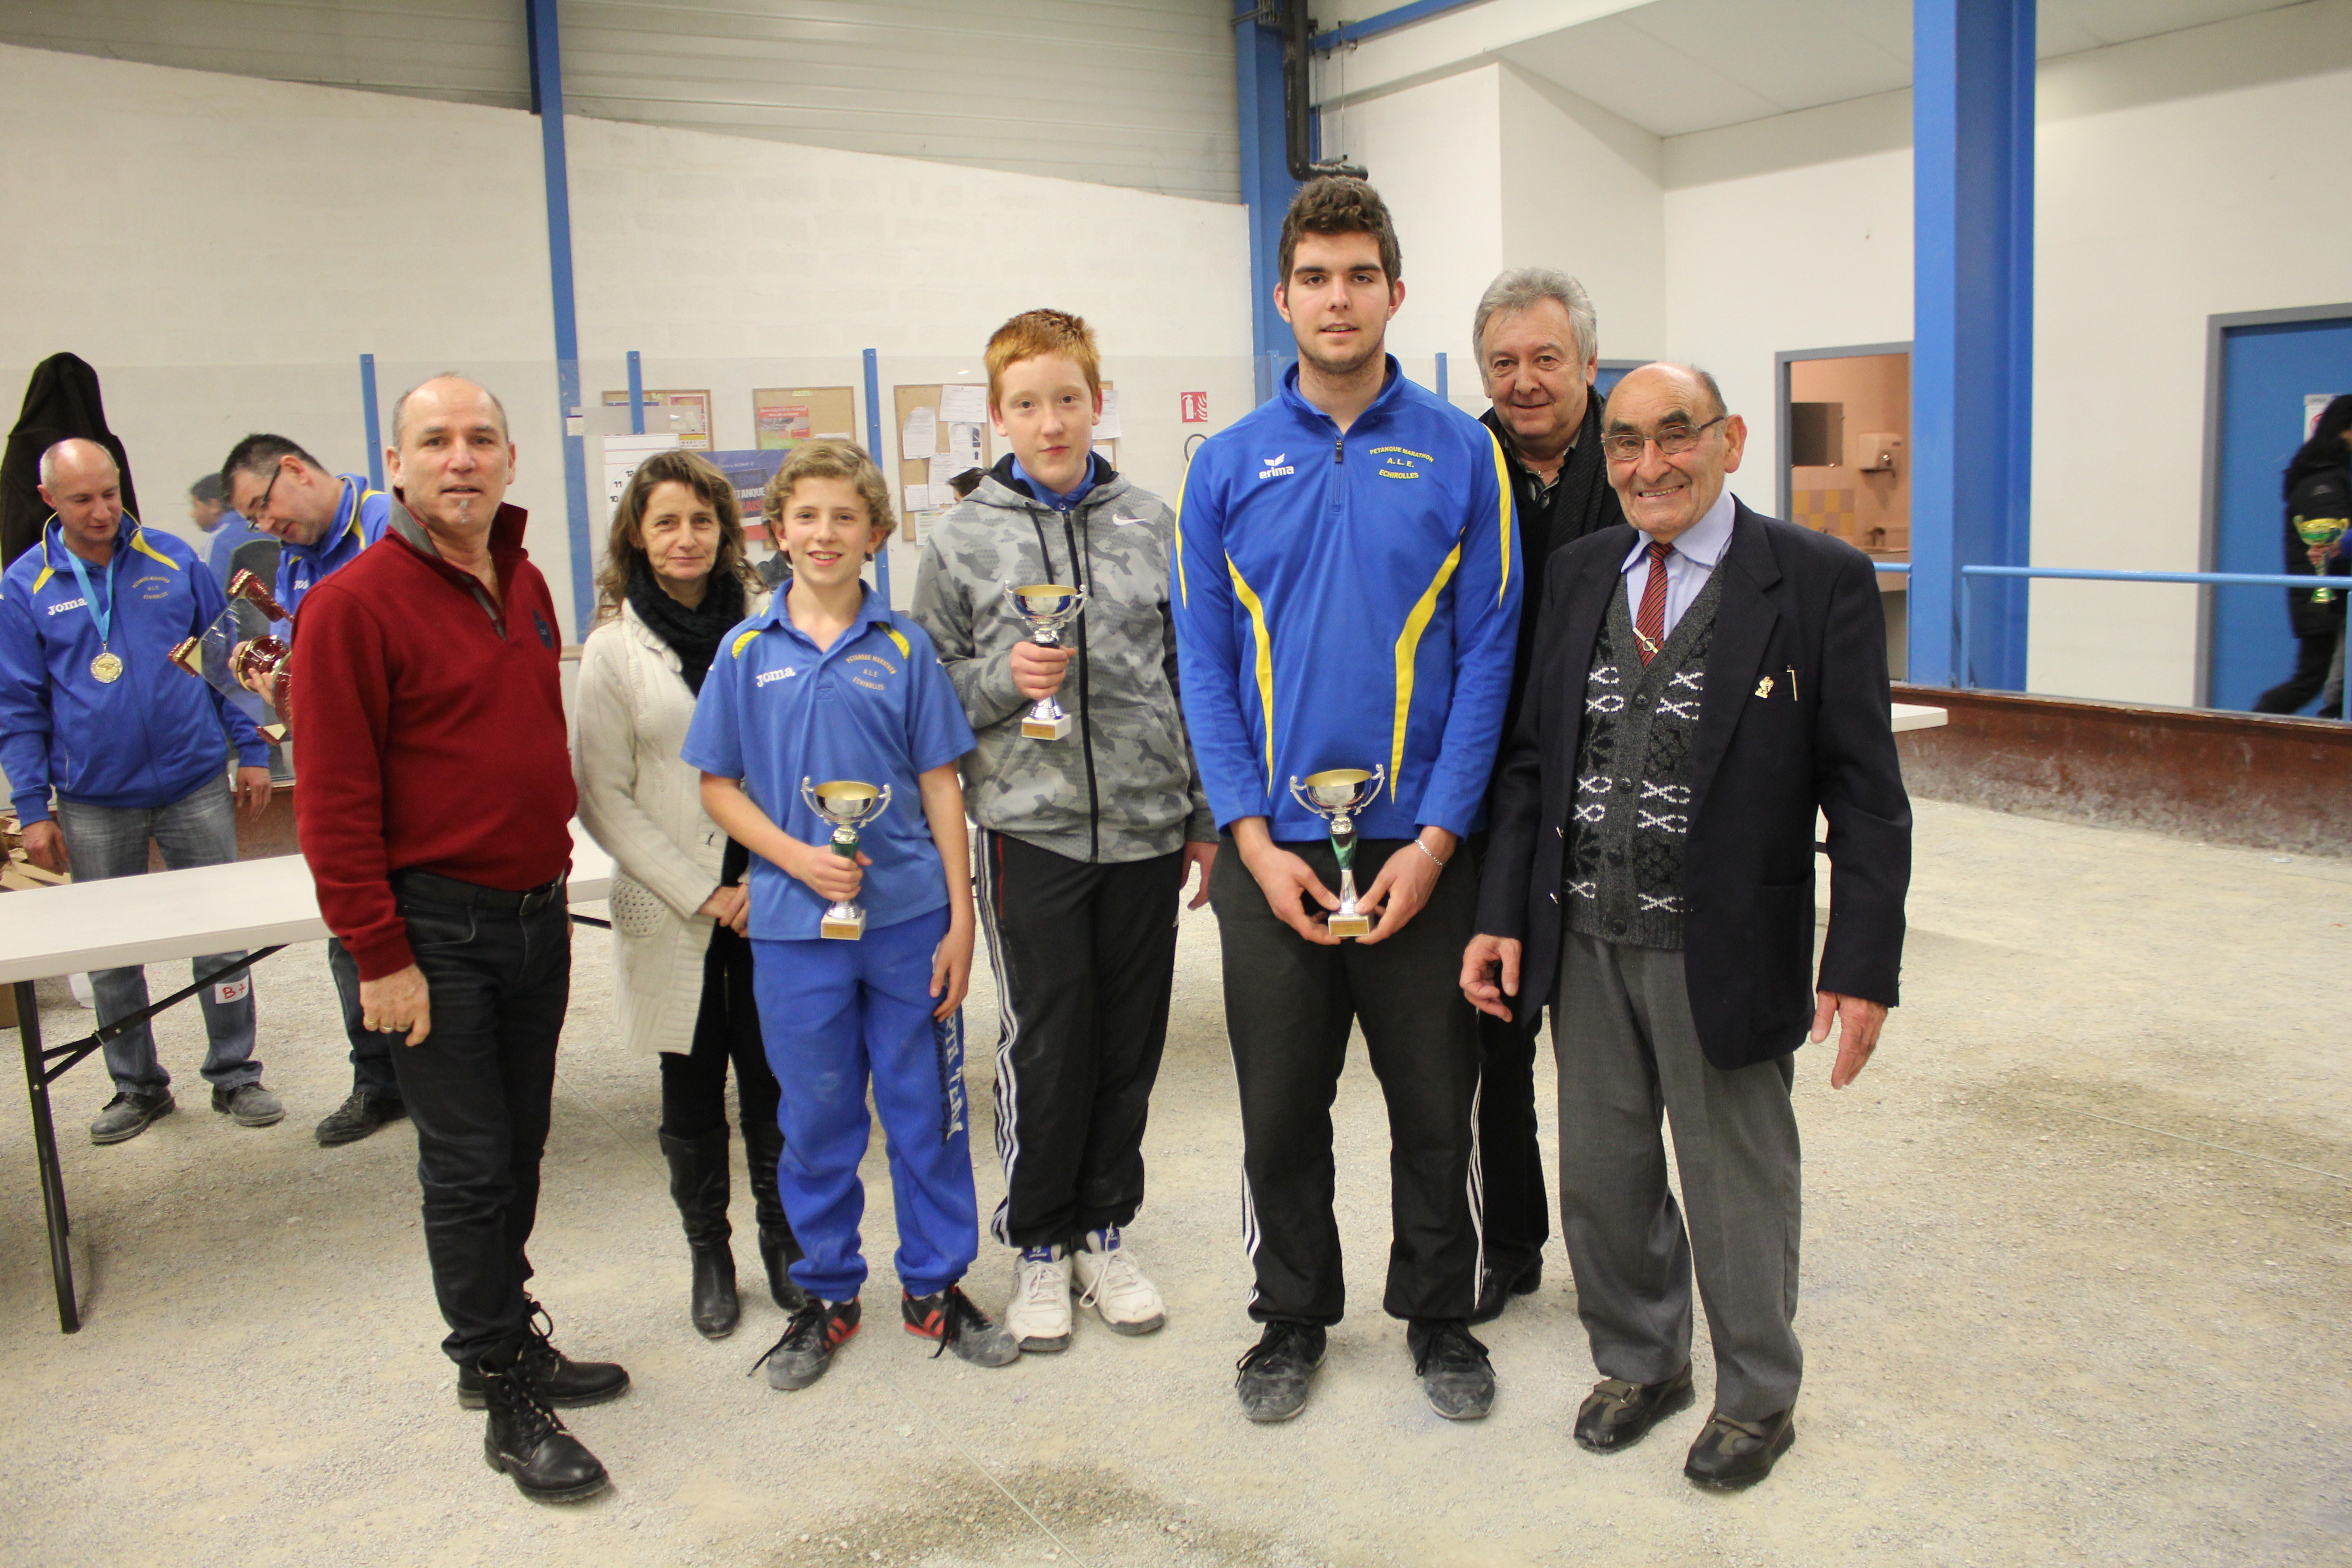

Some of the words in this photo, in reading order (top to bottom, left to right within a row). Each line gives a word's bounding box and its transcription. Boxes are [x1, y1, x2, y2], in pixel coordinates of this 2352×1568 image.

[1369, 446, 1402, 455] PETANQUE
[1402, 448, 1434, 463] MARATHON
[1259, 466, 1295, 479] erima
[1378, 469, 1420, 479] ECHIROLLES
[734, 487, 766, 499] TANQUE
[853, 676, 885, 690] ECHIROLLES
